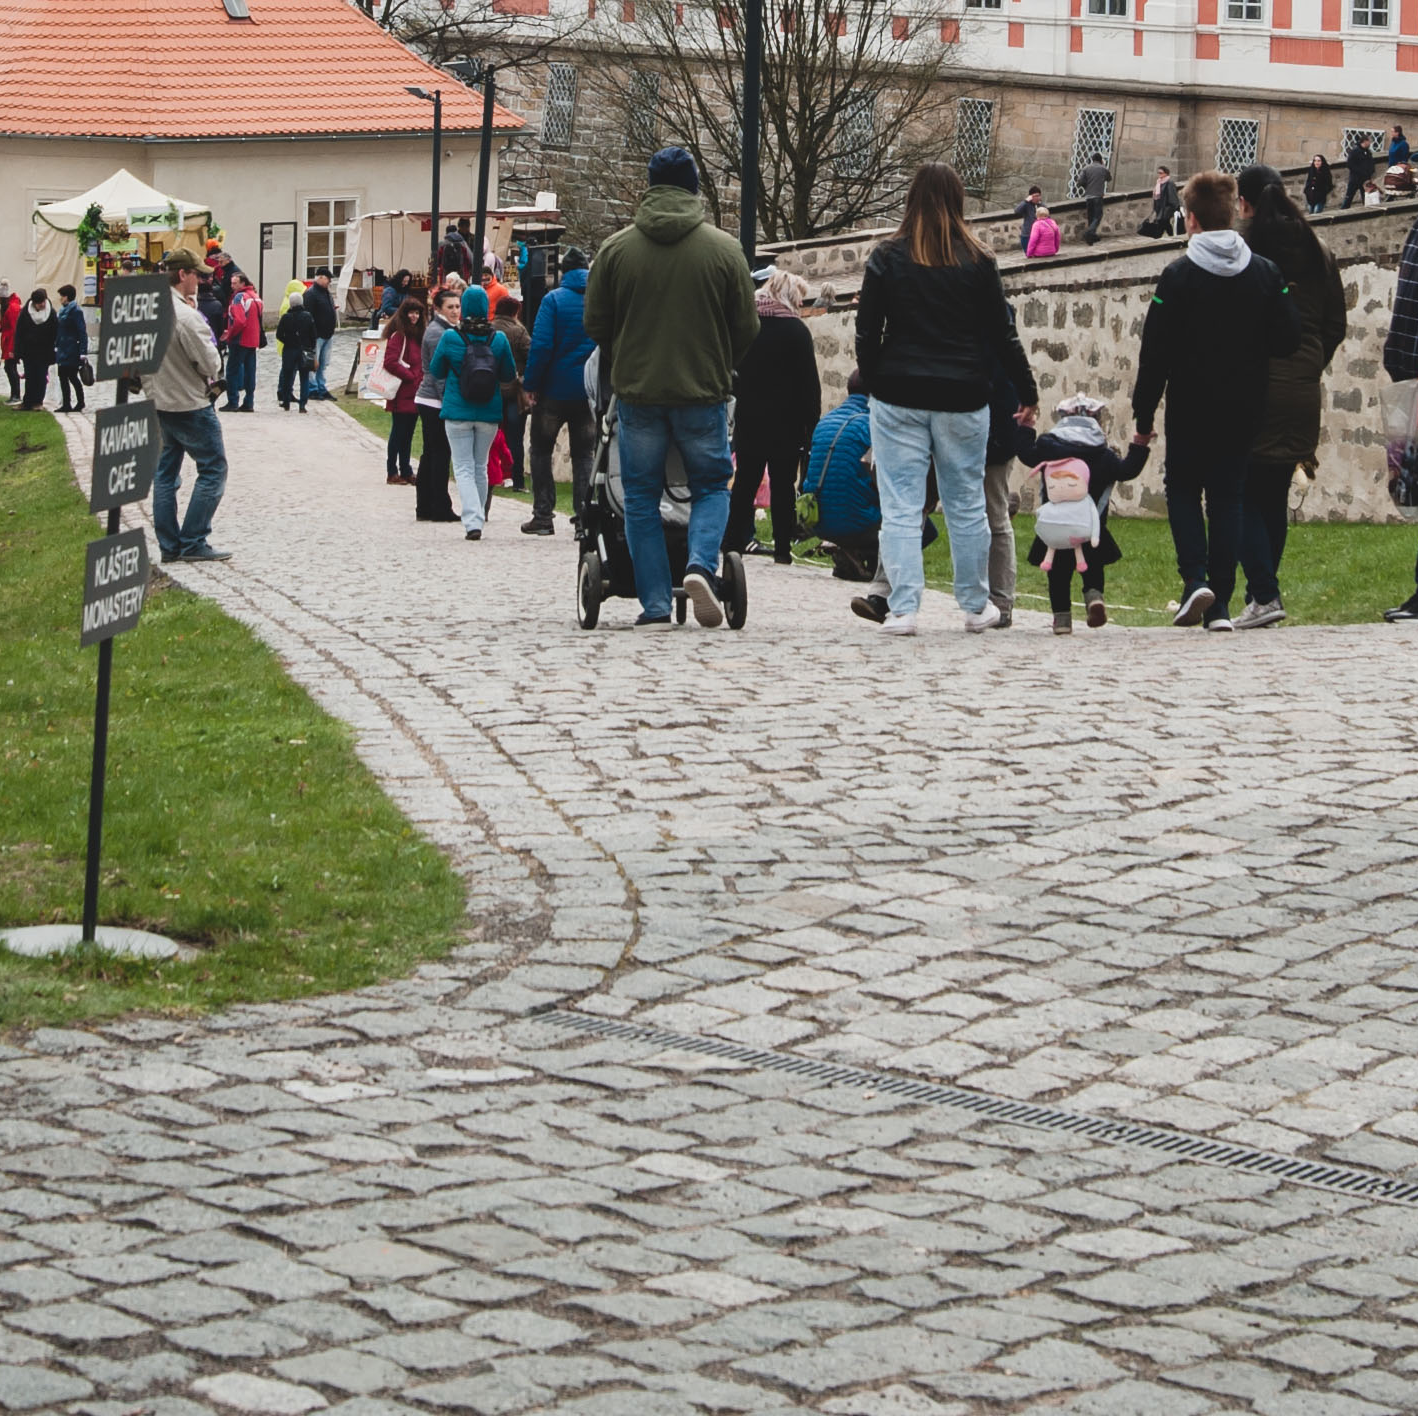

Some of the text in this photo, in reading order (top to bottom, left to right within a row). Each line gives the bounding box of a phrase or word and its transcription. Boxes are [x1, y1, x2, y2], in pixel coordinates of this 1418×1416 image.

[111, 292, 160, 324] GALERIE
[106, 332, 158, 366] GALLERY
[100, 416, 149, 456] KAVÁRNA
[108, 454, 137, 496] CAFÉ
[94, 544, 139, 588] KLÁŠTER
[83, 584, 145, 634] MONASTERY
